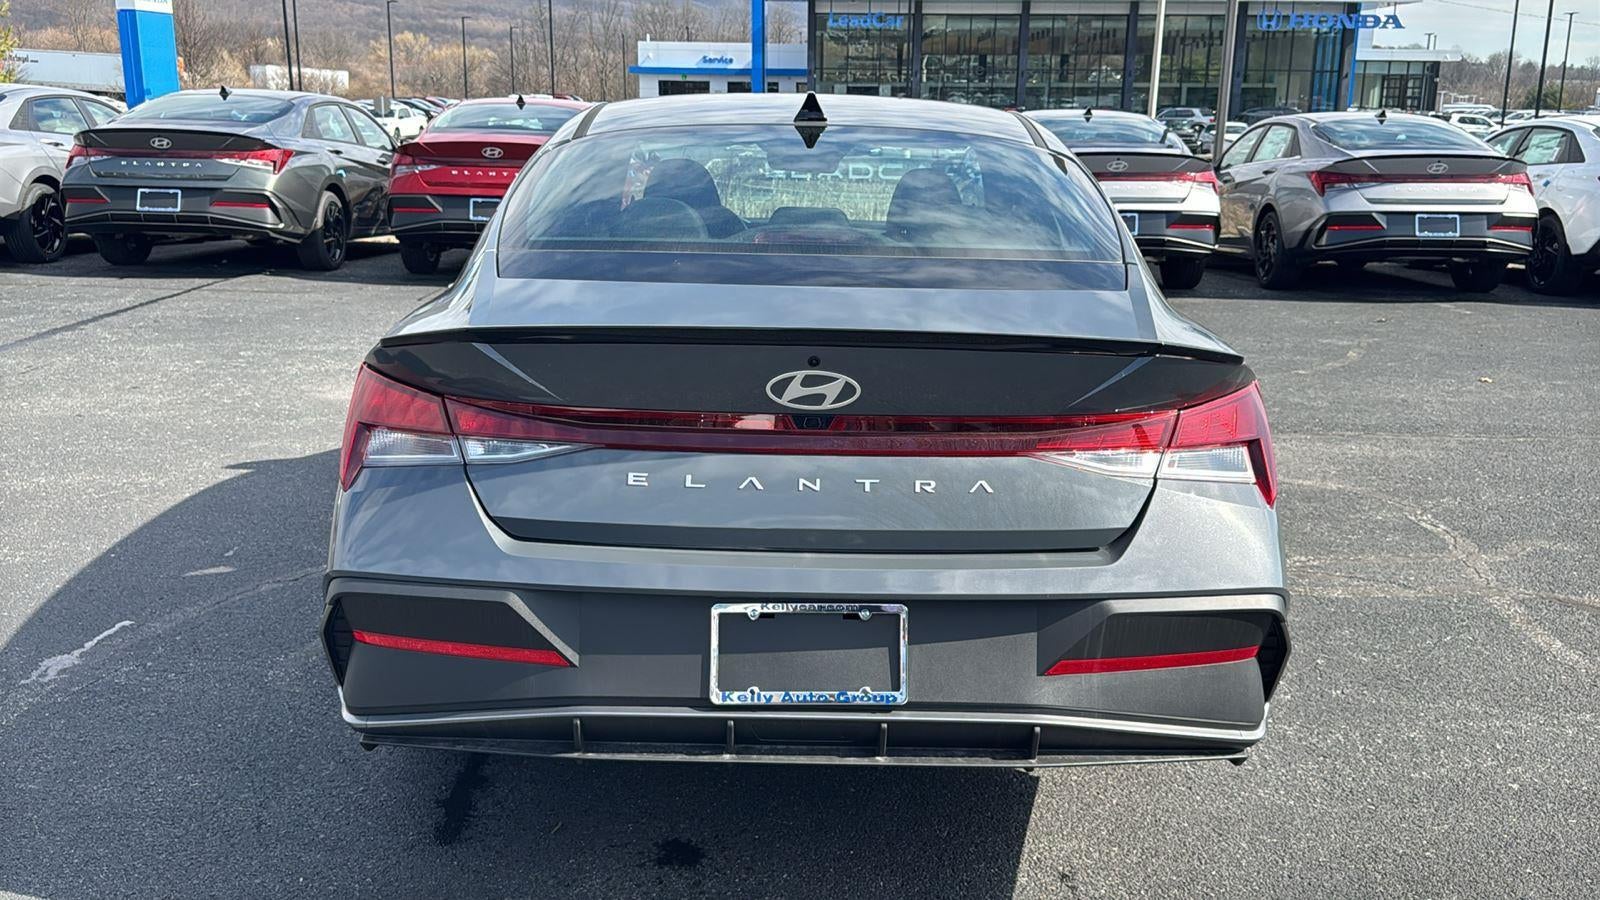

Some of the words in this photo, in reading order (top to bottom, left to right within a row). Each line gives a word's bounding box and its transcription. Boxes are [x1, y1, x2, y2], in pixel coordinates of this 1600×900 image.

[828, 12, 904, 28] LeadCar
[1288, 12, 1405, 29] HONDA
[702, 55, 734, 64] Service
[627, 472, 994, 494] ELANTRA
[721, 691, 773, 704] Kelly
[781, 691, 831, 704] Auto
[836, 691, 897, 704] Group
